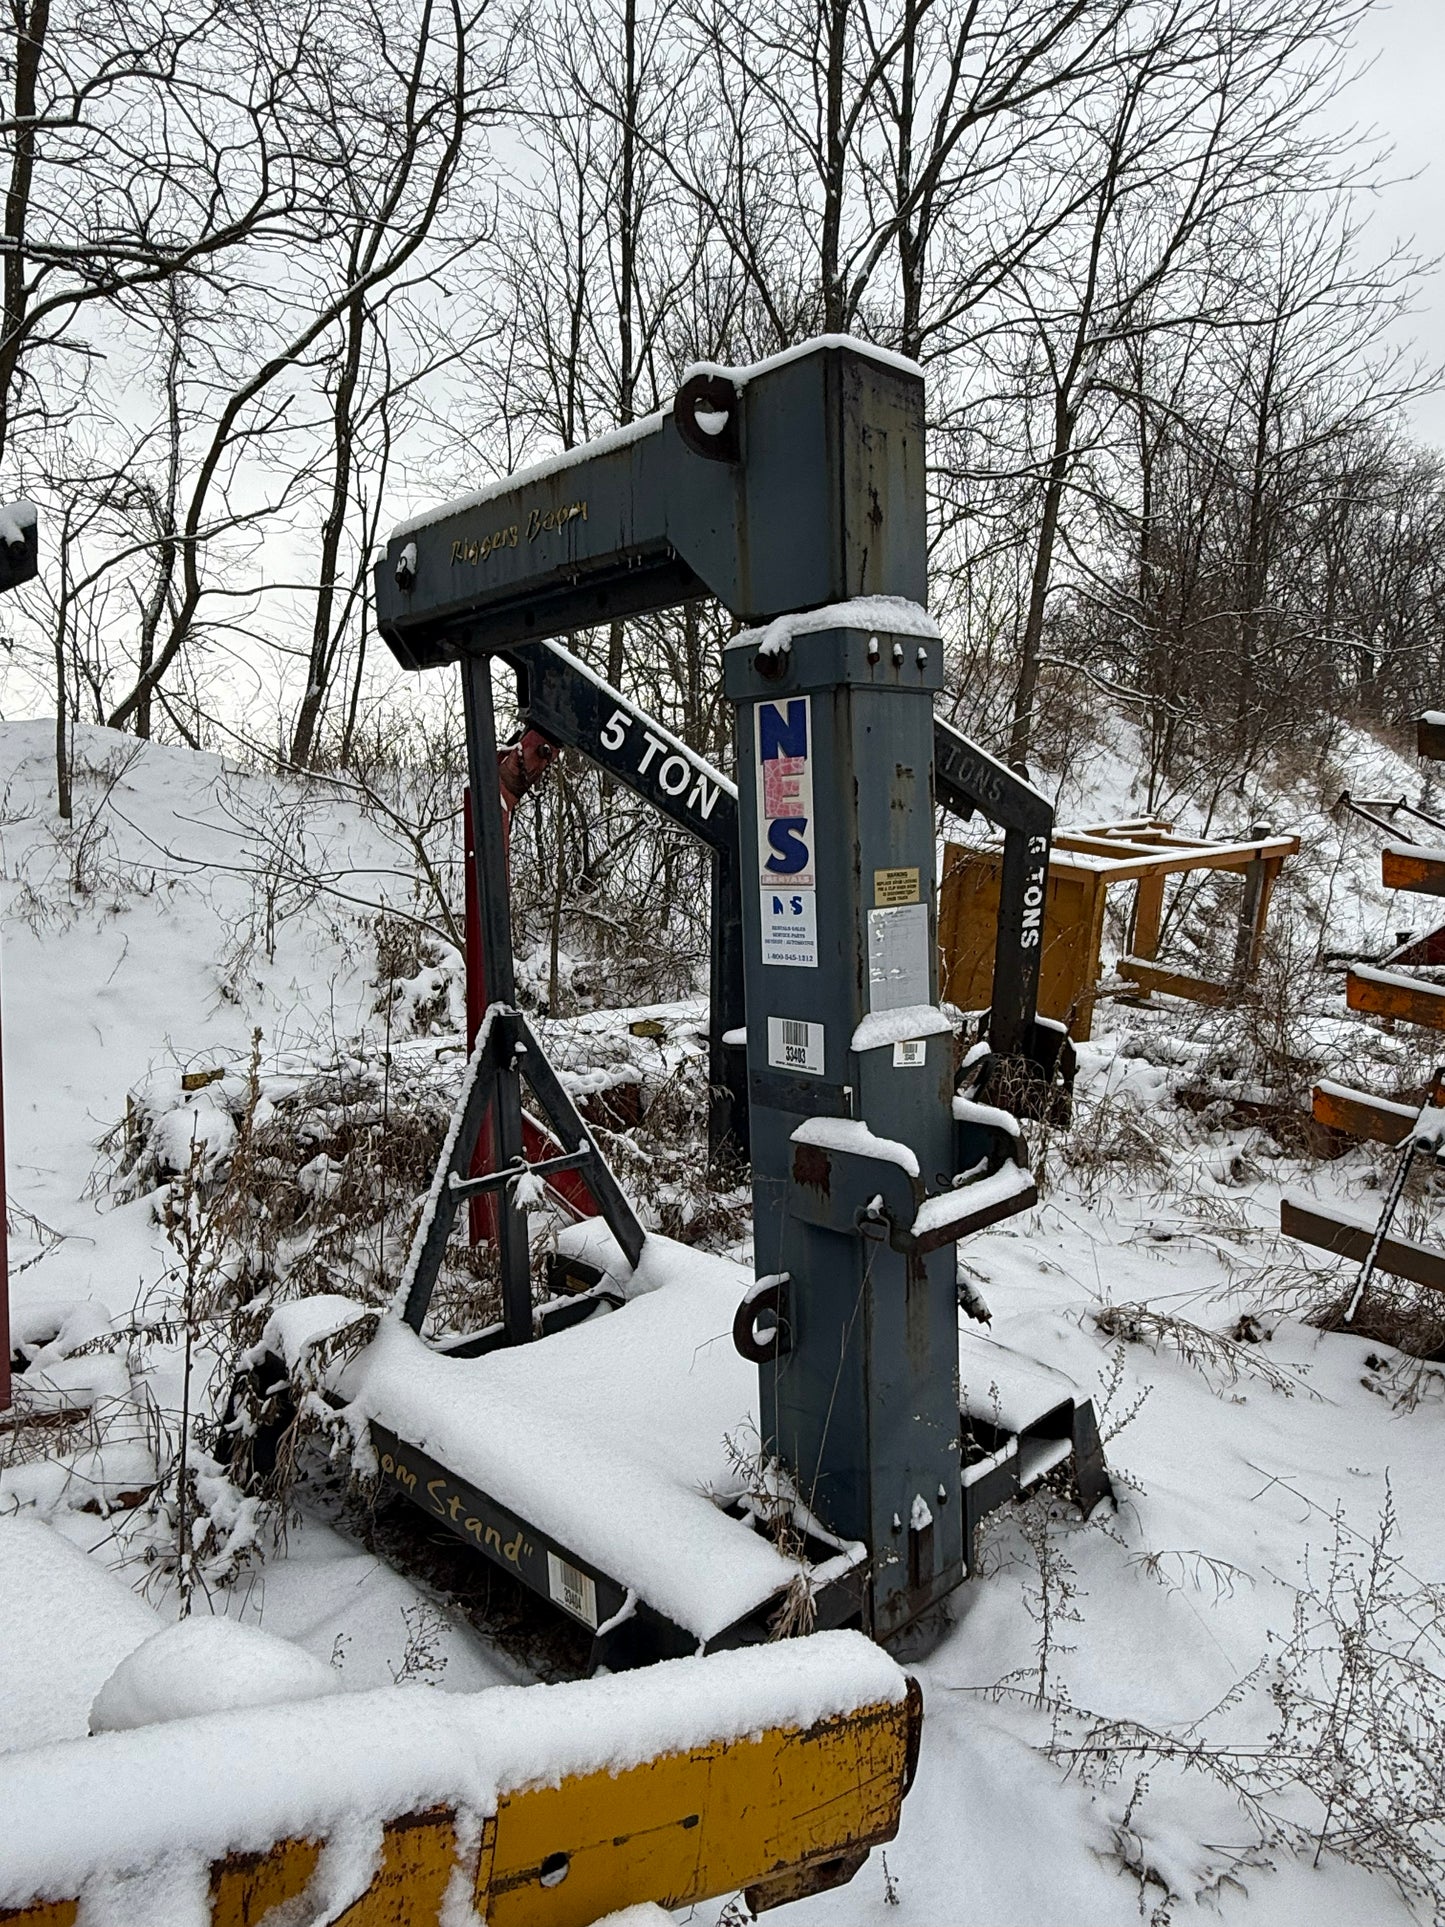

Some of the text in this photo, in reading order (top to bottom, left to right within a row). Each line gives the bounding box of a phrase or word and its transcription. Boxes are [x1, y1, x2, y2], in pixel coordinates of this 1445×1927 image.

[450, 524, 519, 566] Riggers
[600, 709, 722, 820] 5 TON
[758, 698, 810, 875] NES
[945, 743, 1004, 801] TONS
[1020, 867, 1045, 948] TONS
